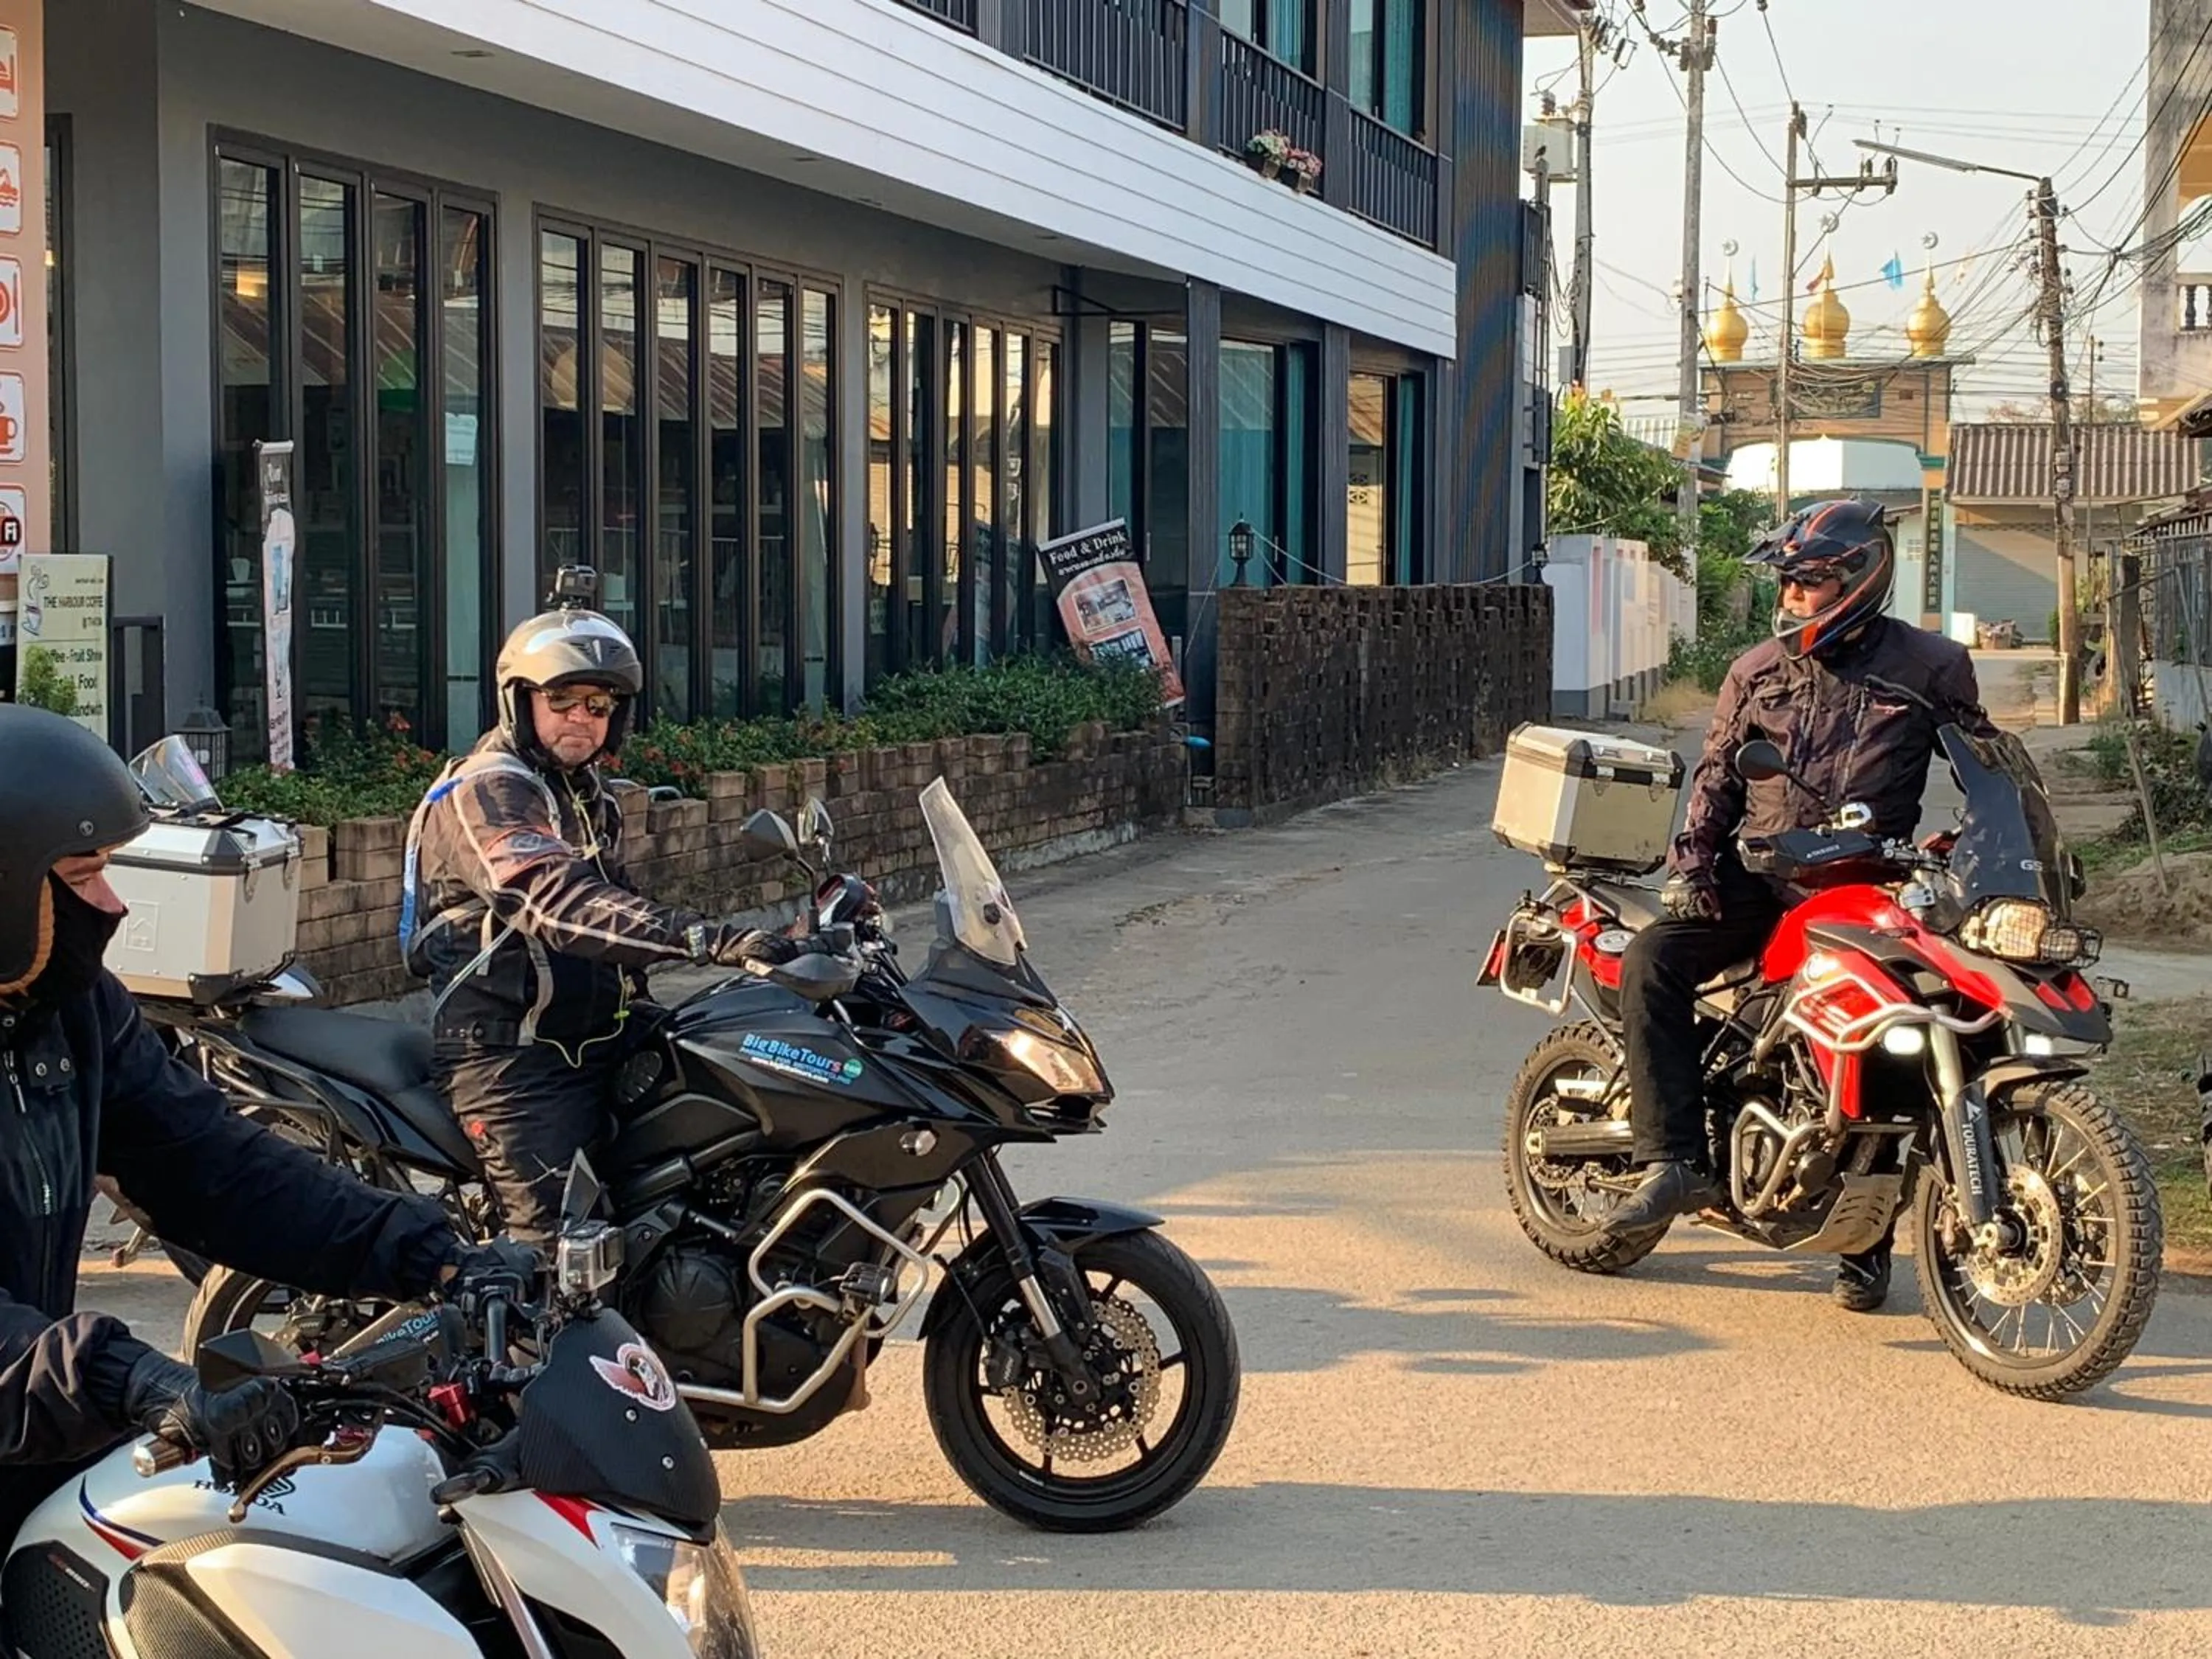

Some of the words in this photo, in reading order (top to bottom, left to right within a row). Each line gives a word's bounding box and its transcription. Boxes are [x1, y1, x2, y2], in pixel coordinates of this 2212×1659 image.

[1049, 546, 1077, 566] Food
[1080, 542, 1091, 554] &
[1093, 531, 1127, 550] Drink
[44, 596, 58, 608] THE
[2020, 860, 2043, 872] GS
[742, 1033, 842, 1074] BigBikeTours
[1961, 1122, 1983, 1195] TOURATECH
